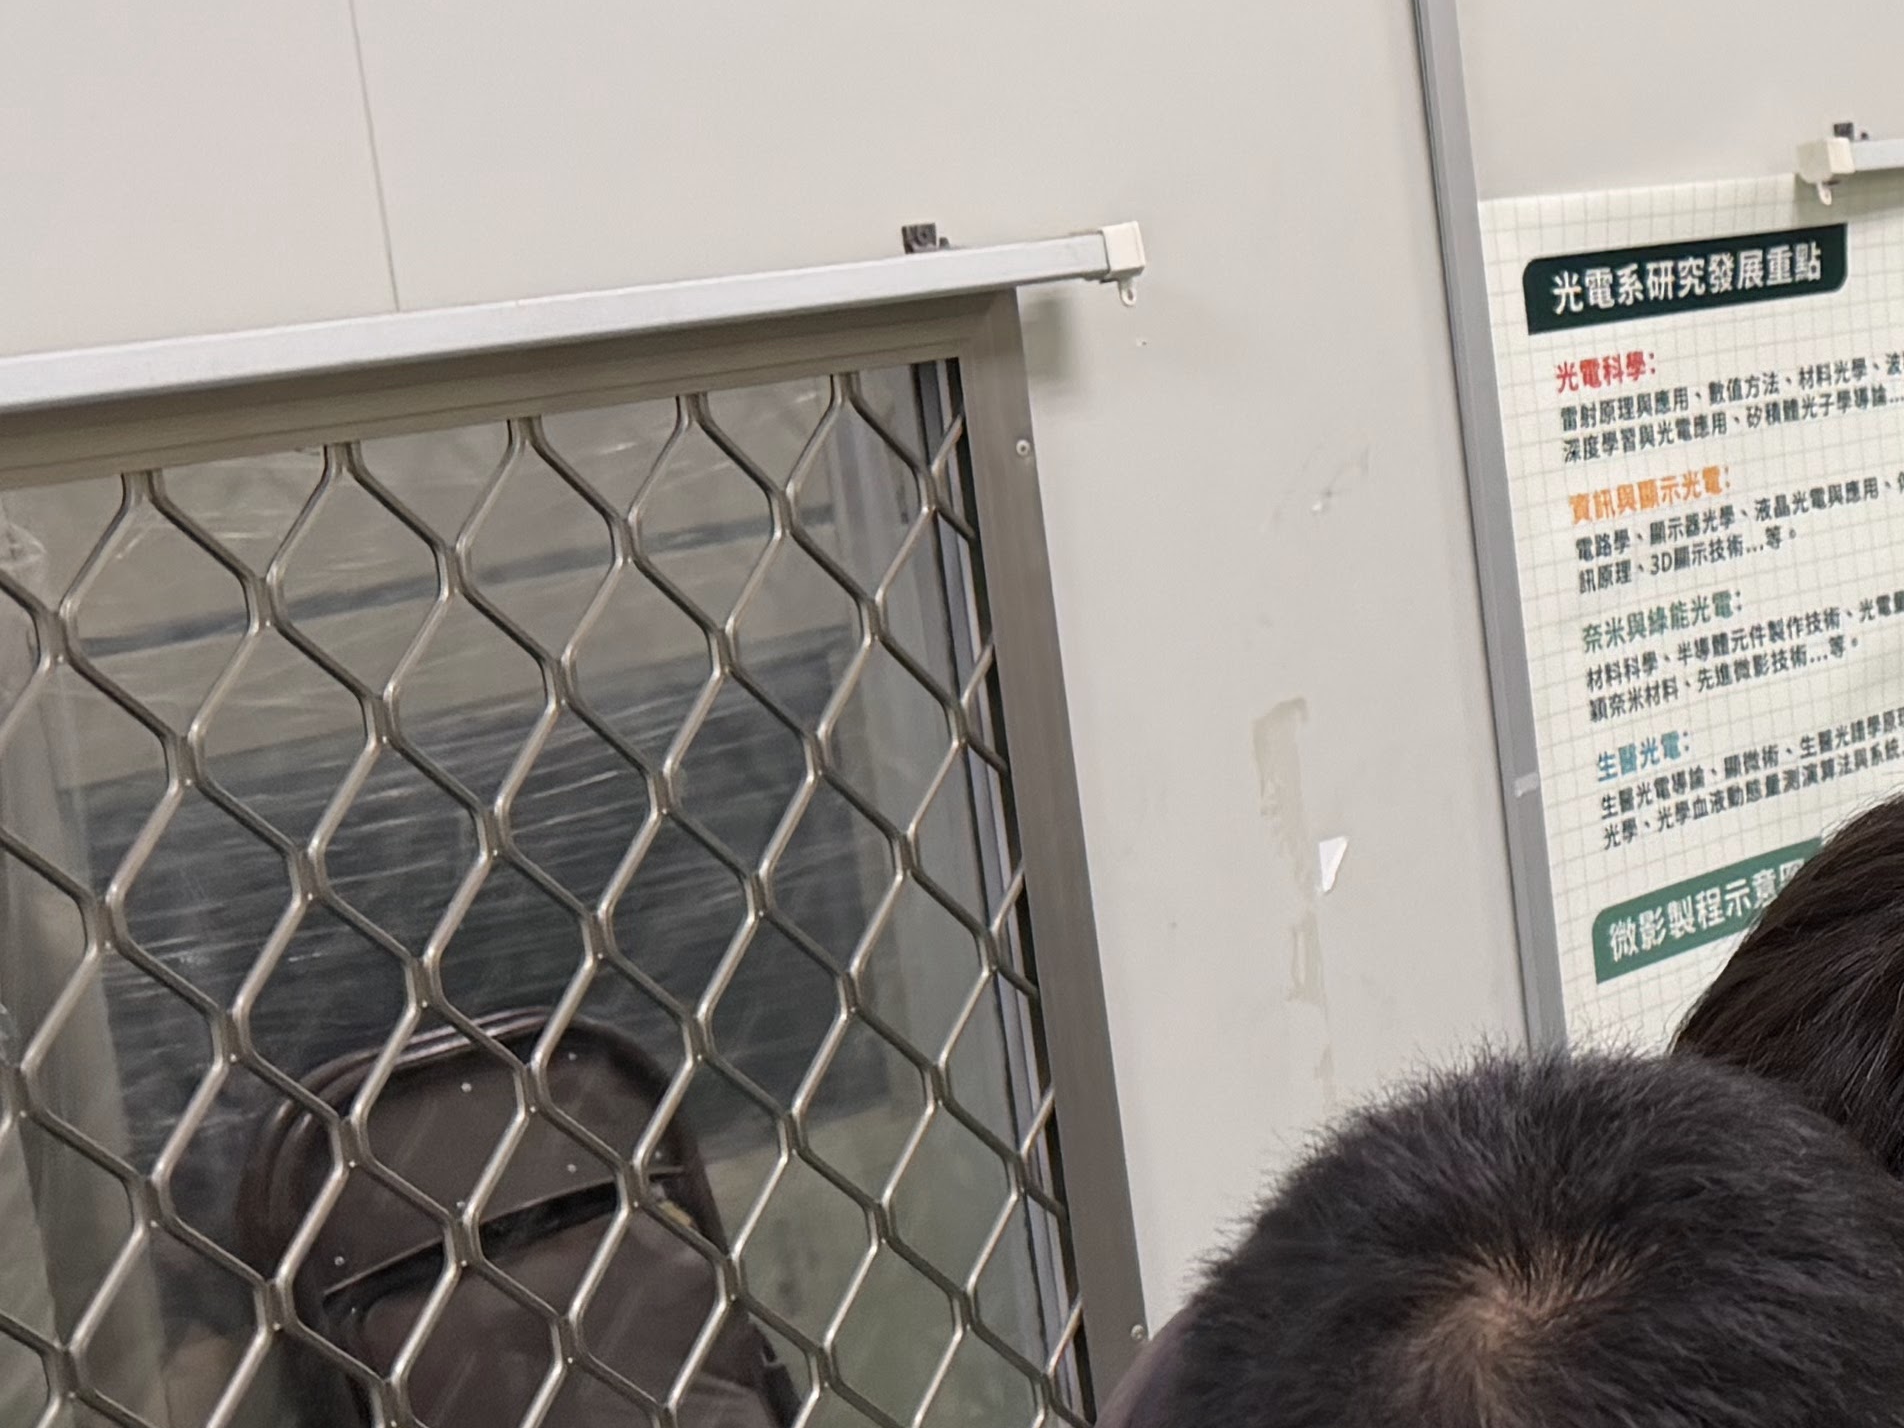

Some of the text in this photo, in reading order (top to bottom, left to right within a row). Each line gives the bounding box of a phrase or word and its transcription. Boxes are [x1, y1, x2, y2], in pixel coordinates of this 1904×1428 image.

[1552, 241, 1822, 315] 光電系研究發展重點
[1556, 350, 1656, 393] 光電科學：
[1569, 465, 1731, 525] 資訊與顯示光電：
[1582, 590, 1742, 654] 奈米與綠能光電：
[1597, 730, 1690, 782] 生醫光電：
